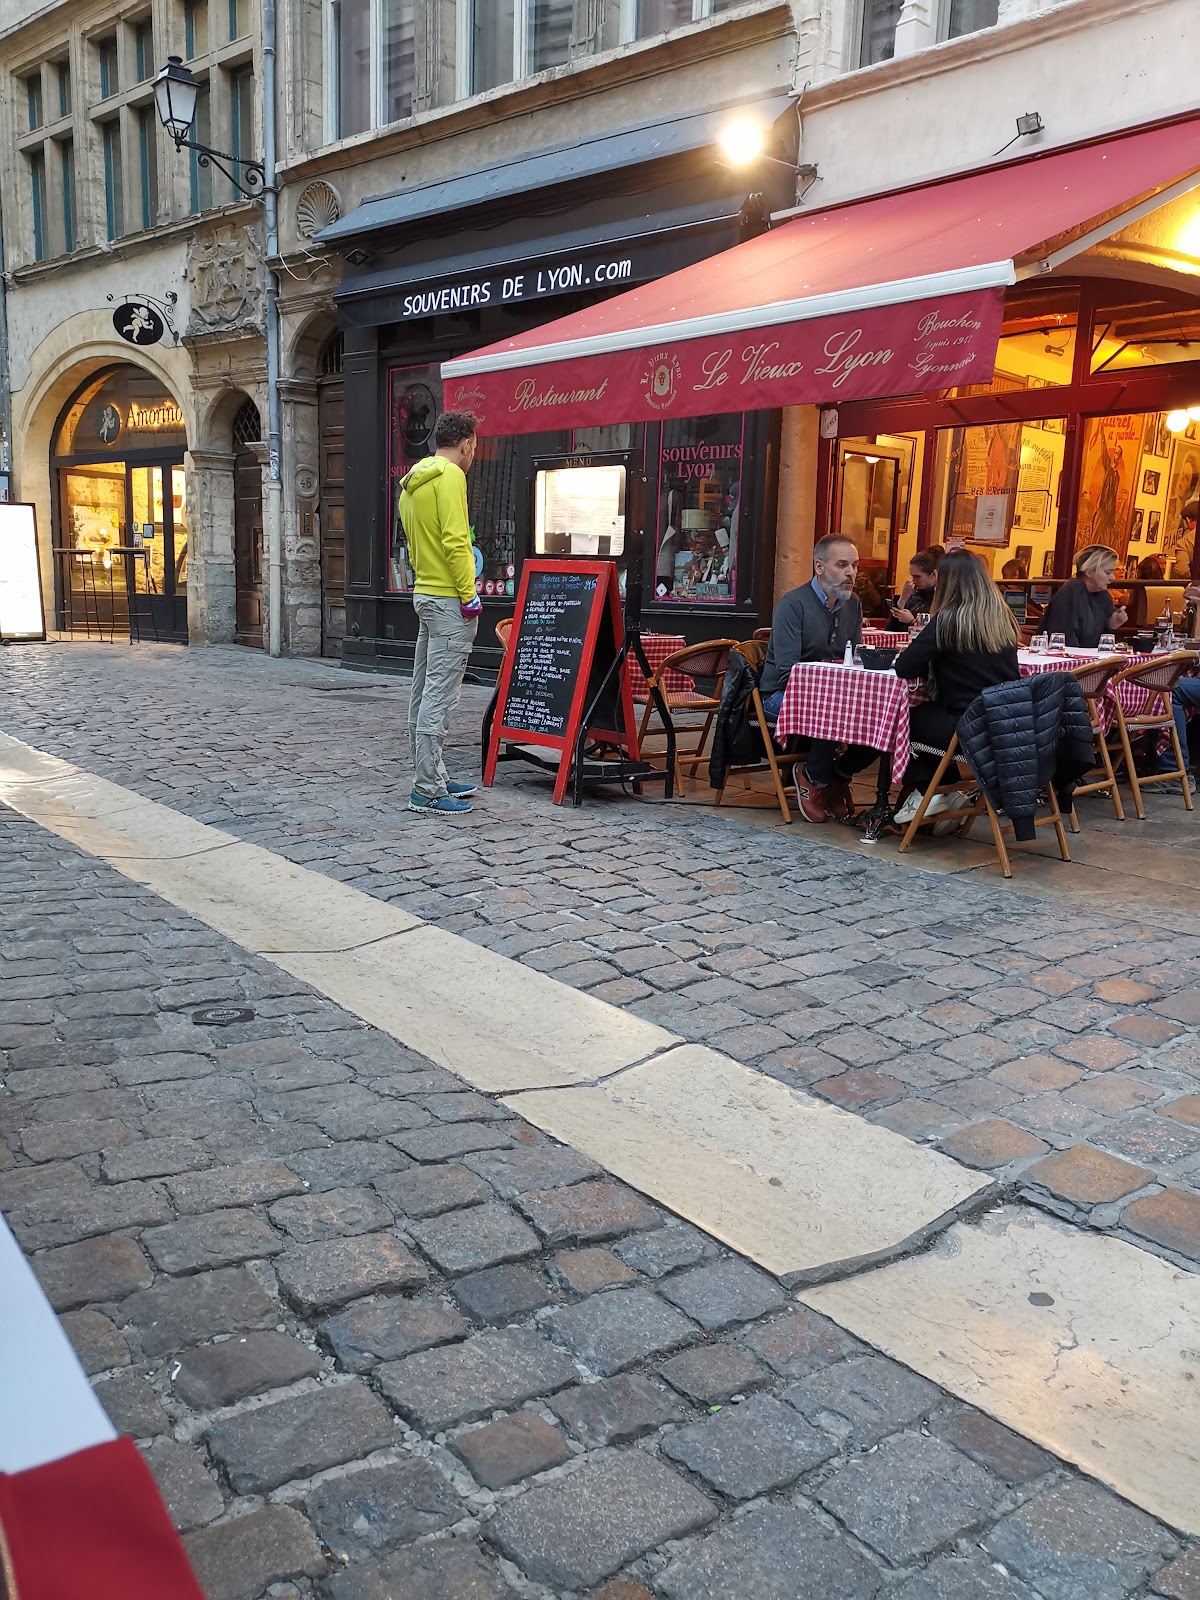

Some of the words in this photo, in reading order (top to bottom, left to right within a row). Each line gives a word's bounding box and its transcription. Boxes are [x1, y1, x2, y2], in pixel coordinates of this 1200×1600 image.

[403, 281, 491, 316] SOUVENIRS
[502, 275, 525, 298] DE
[537, 259, 632, 293] LYON.com
[913, 309, 982, 341] Bouchon
[693, 349, 733, 391] Le
[739, 341, 803, 385] Vieux
[814, 329, 894, 388] Lyon
[908, 352, 977, 378] Lyonnais
[508, 378, 609, 412] Restaurant
[126, 402, 182, 427] Amorino
[565, 457, 592, 467] MENU
[662, 440, 742, 462] souvenirs
[677, 461, 715, 484] Lyon
